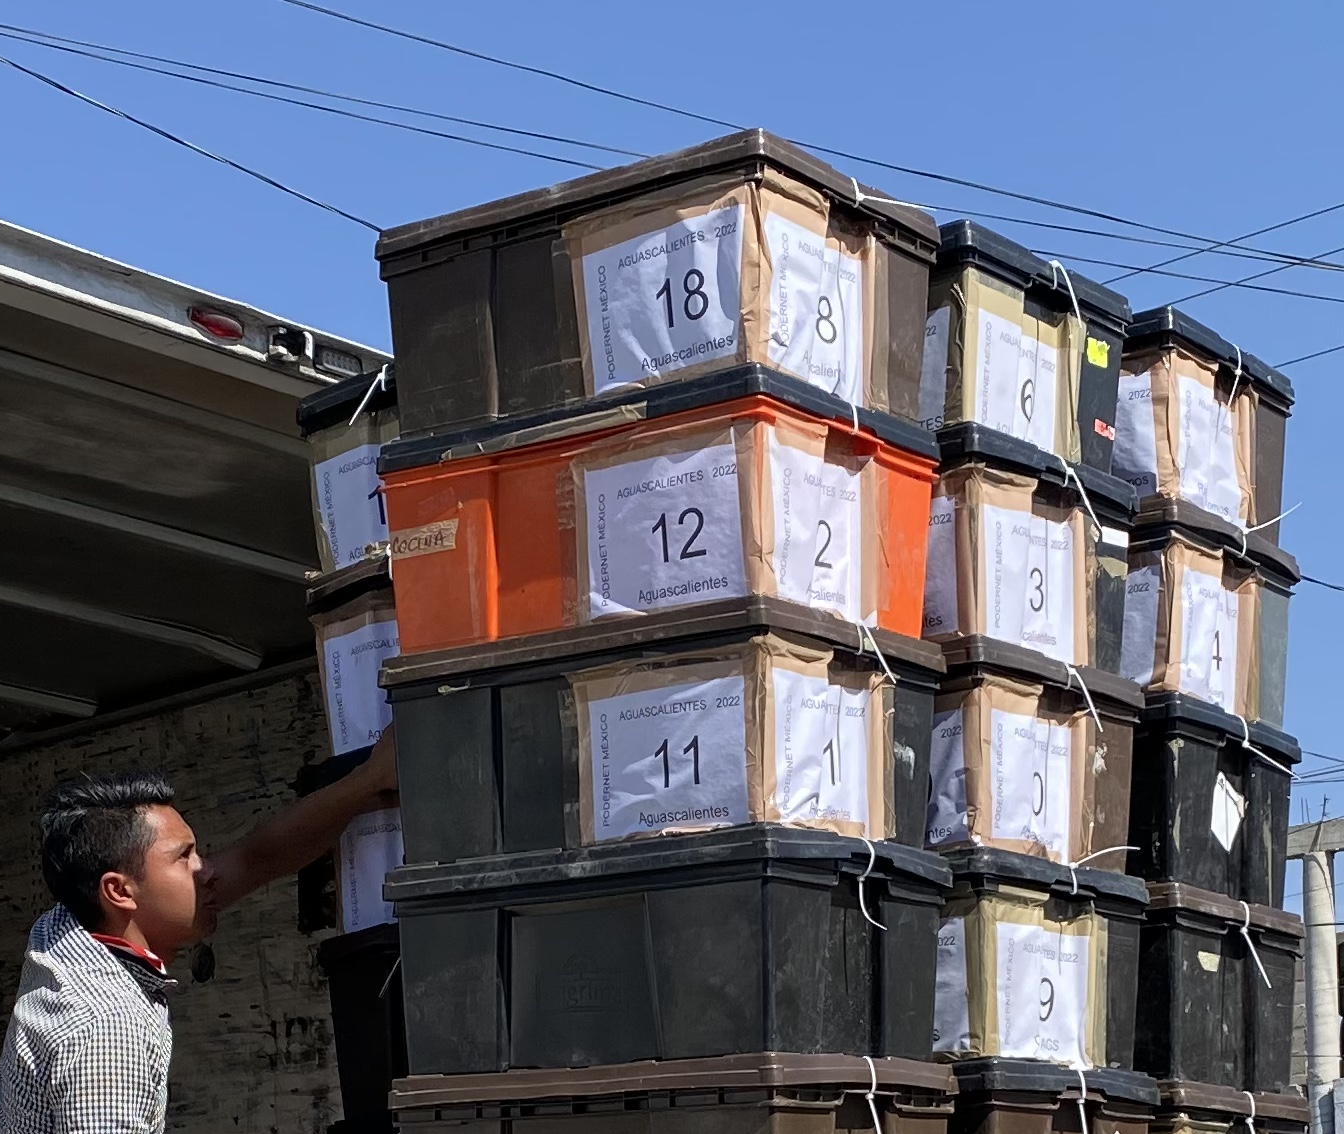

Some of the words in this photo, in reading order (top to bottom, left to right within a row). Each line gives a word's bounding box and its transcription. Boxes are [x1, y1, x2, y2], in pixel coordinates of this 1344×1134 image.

[618, 230, 705, 270] AGUASCALIENTES
[714, 222, 737, 239] 2022
[656, 268, 709, 329] 18
[603, 314, 616, 380] PODERNET
[641, 334, 734, 372] Aguascalientes
[617, 470, 704, 500] AGUASCALIENTES
[712, 463, 738, 479] 2022
[651, 507, 707, 563] 12
[815, 519, 833, 569] 2
[599, 542, 611, 607] PODERNET
[638, 575, 728, 605] Aguascalientes
[1029, 568, 1044, 612] 3
[619, 700, 707, 722] AGUASCALIENTES
[716, 696, 741, 709] 2022
[941, 725, 962, 739] 2022
[654, 735, 700, 789] 11
[603, 762, 611, 827] PODERNET
[638, 805, 729, 828] Aguascalientes
